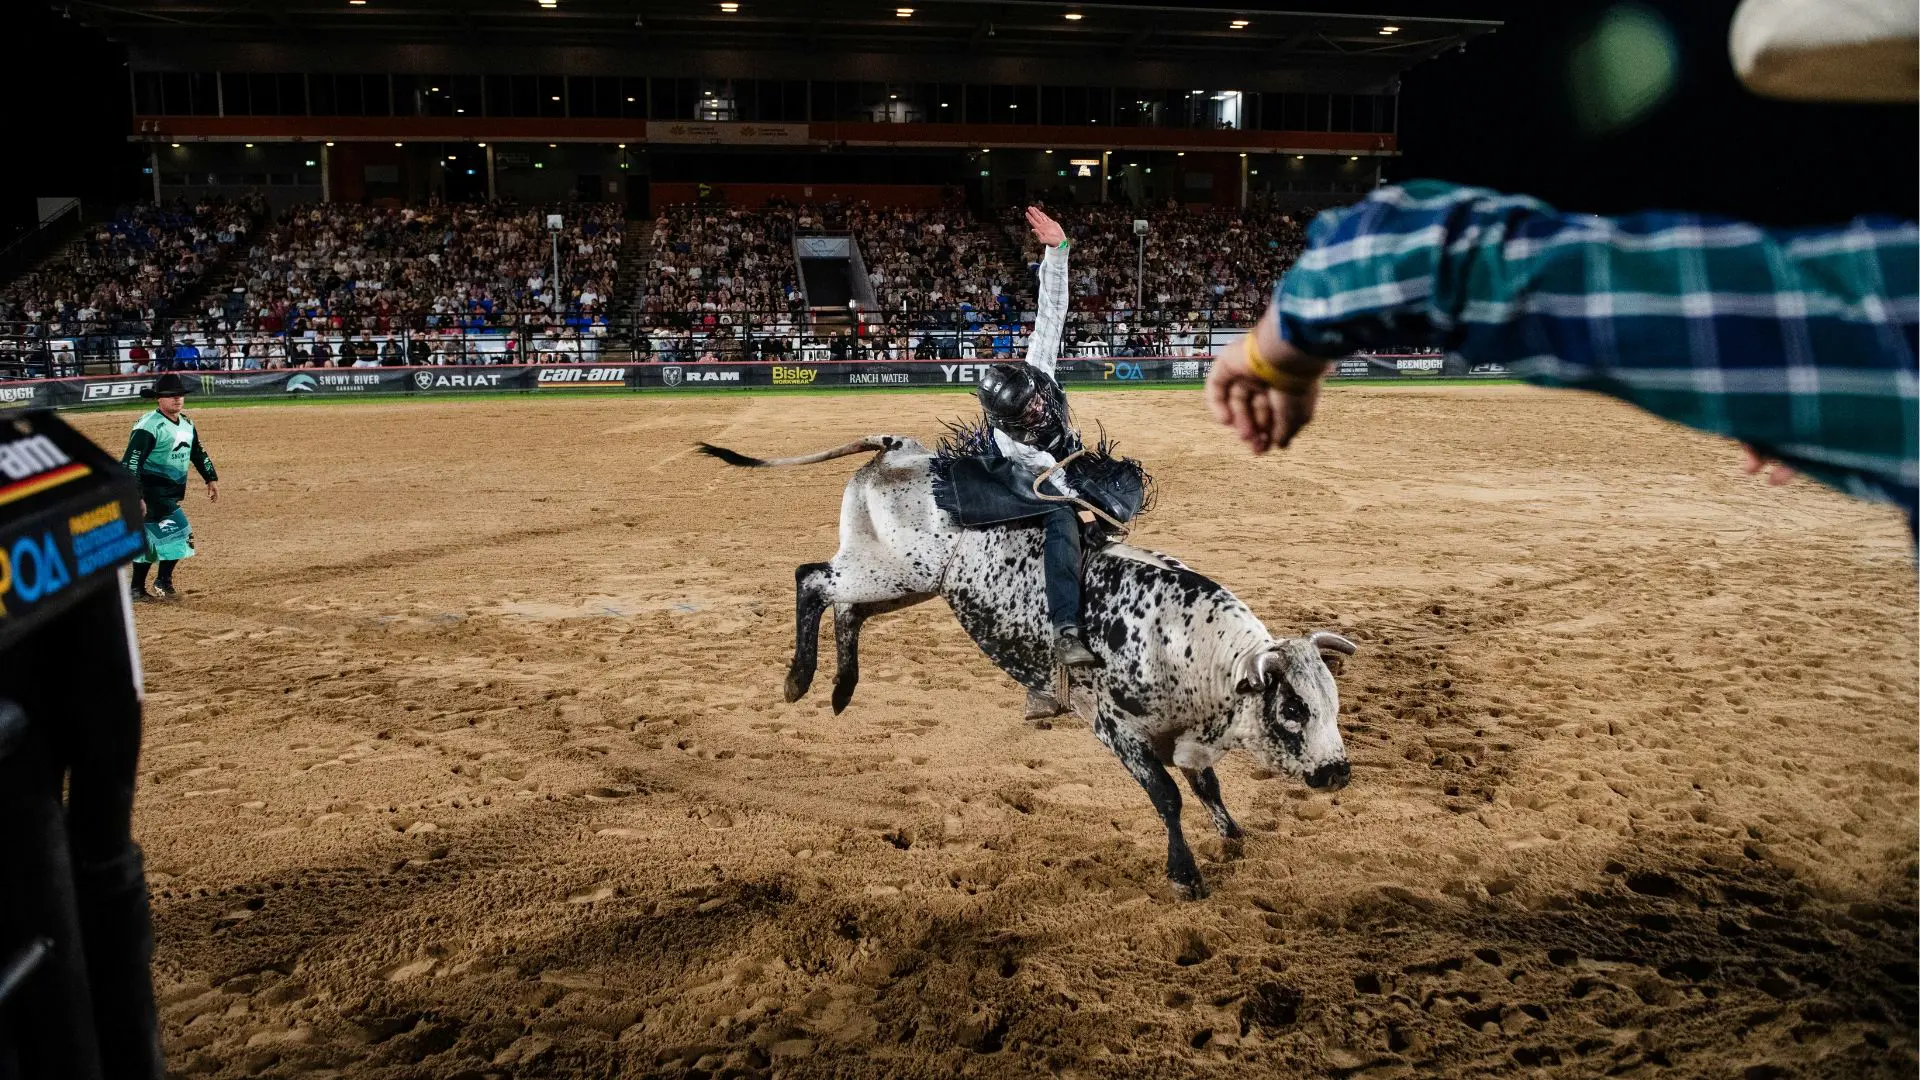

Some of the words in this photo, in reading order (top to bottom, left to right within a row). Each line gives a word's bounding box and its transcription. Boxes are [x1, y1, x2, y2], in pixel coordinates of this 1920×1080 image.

[1104, 362, 1144, 380] POA
[1396, 359, 1443, 370] BEENLEIGH
[537, 368, 625, 382] can-am
[686, 371, 740, 381] RAM
[772, 366, 817, 382] Bisley
[849, 373, 879, 383] RANCH
[881, 373, 909, 383] WATER
[940, 364, 990, 382] YET
[319, 375, 350, 385] SNOWY
[354, 375, 380, 385] RIVER
[435, 374, 500, 387] ARIAT
